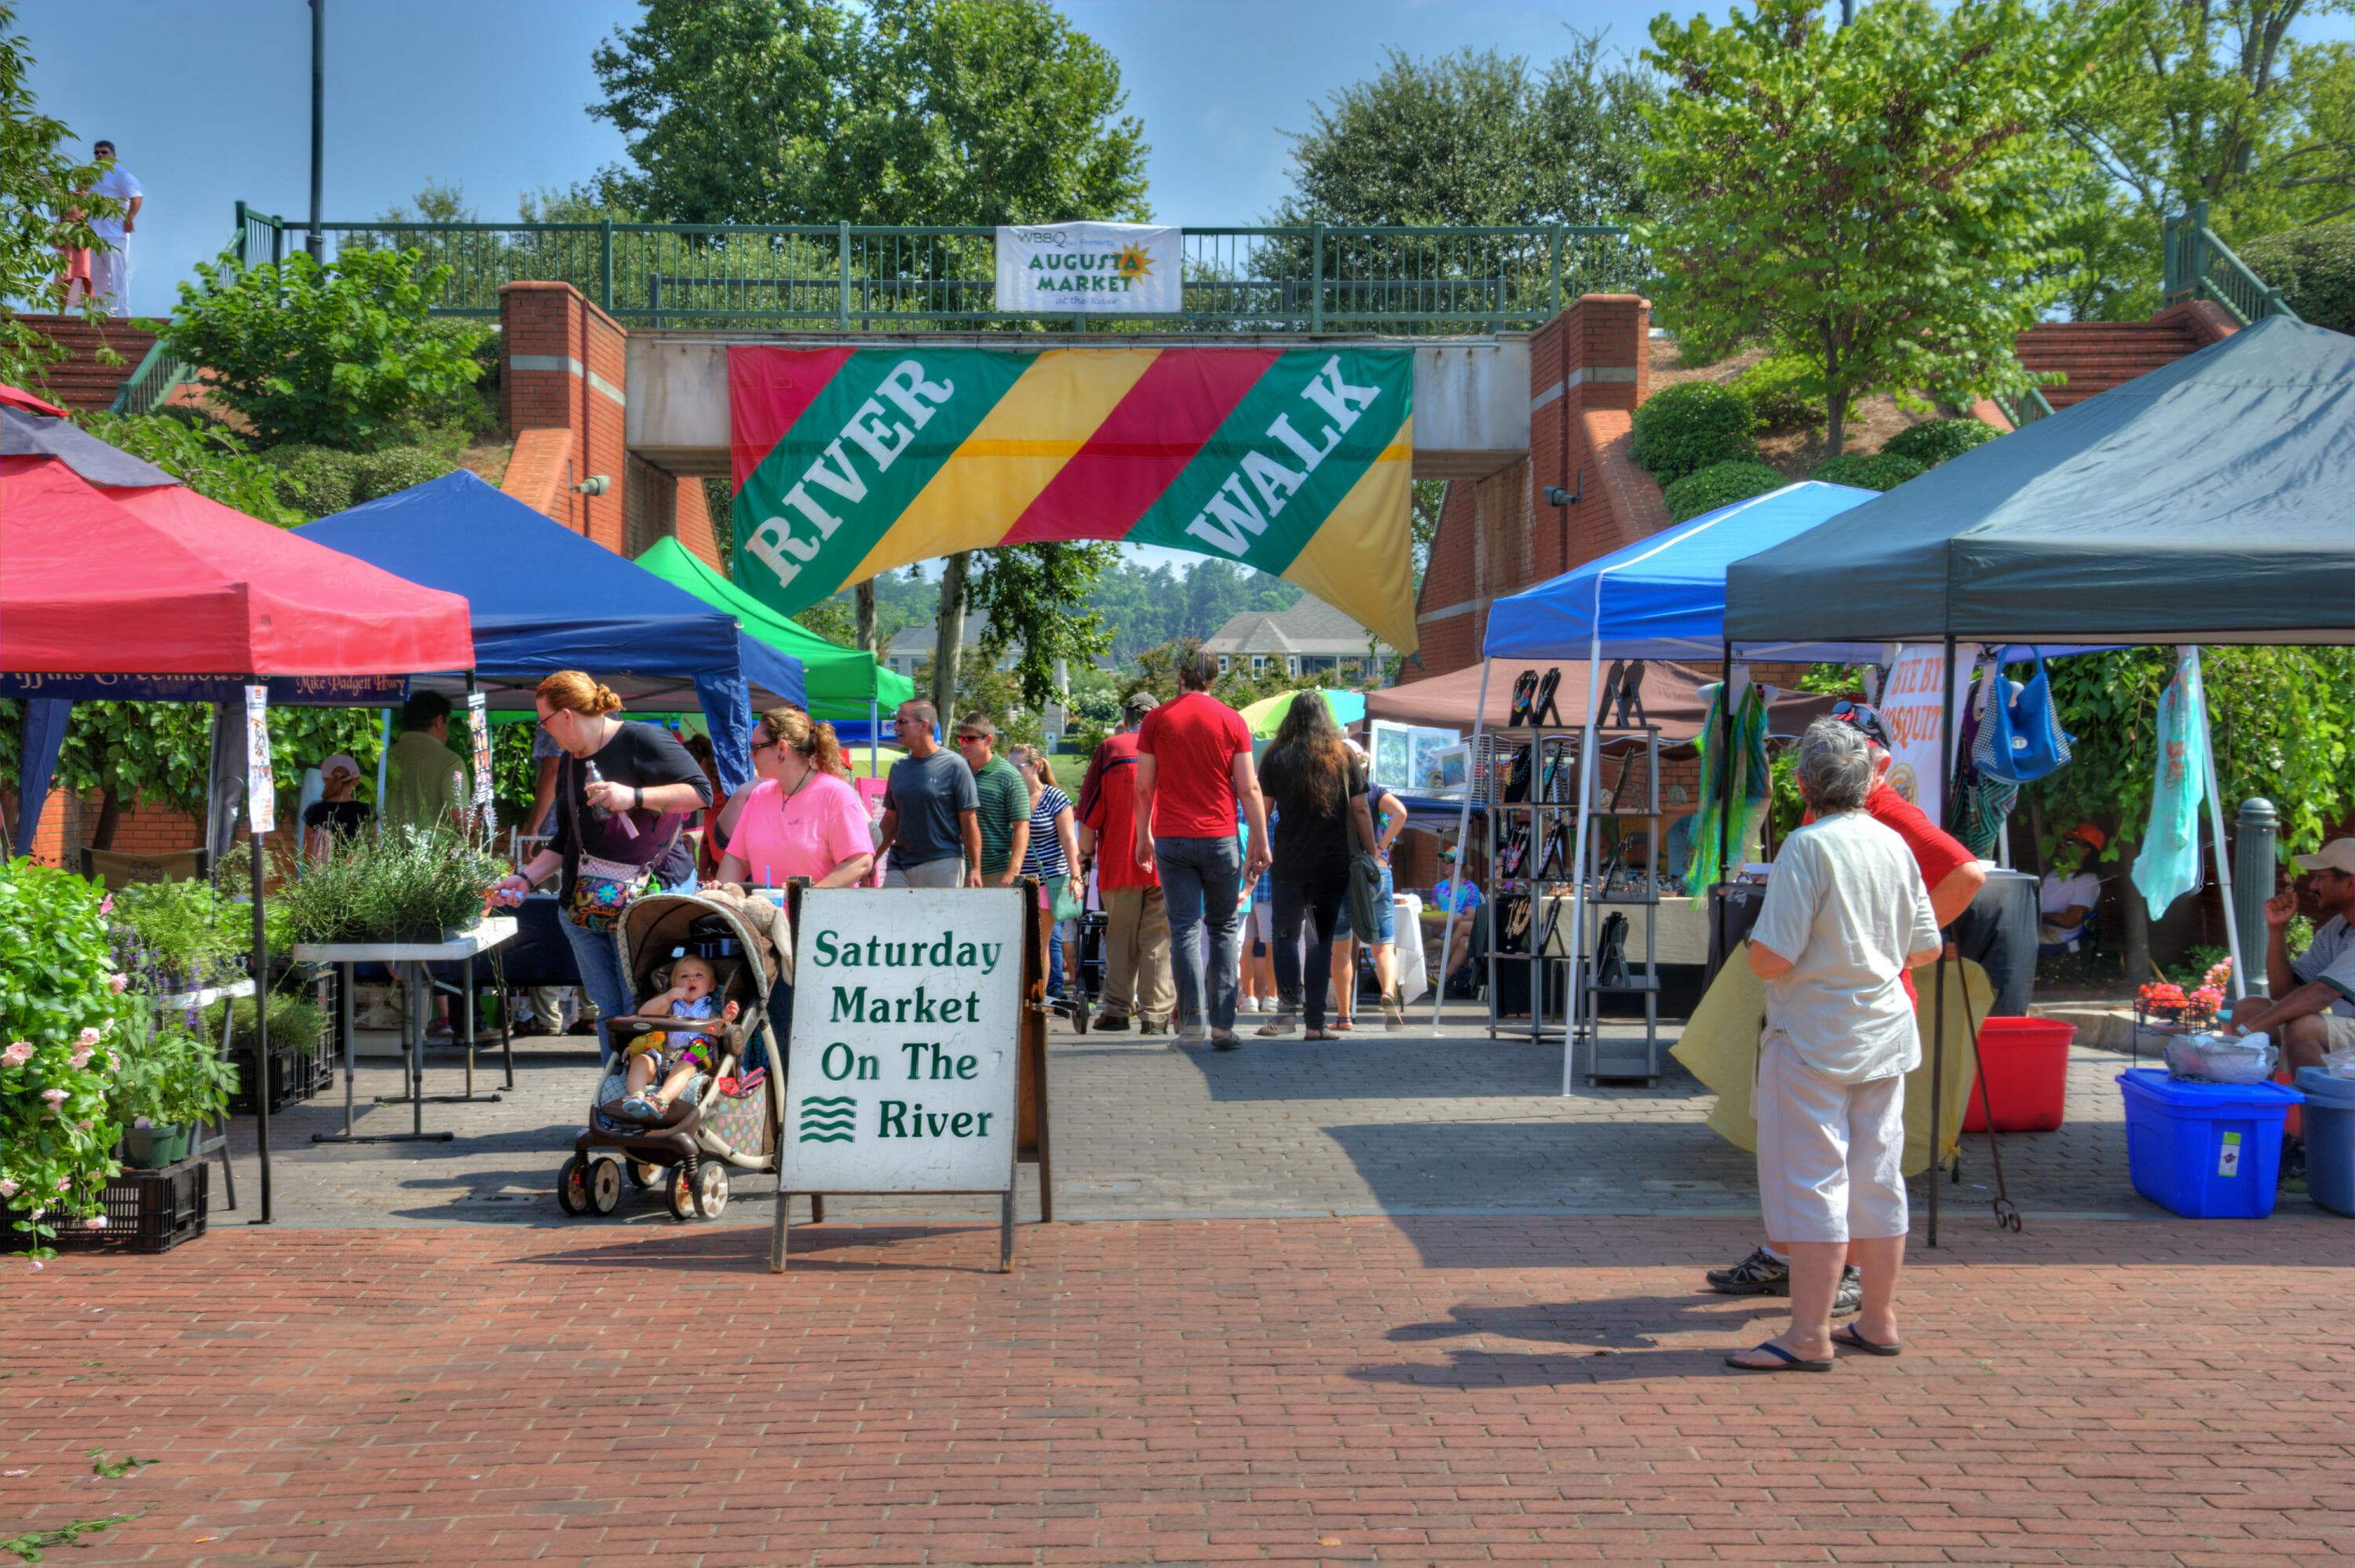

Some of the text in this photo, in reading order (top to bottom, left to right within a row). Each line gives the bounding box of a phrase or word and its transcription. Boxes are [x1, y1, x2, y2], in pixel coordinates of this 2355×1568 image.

[1018, 232, 1066, 248] WBBQ
[1029, 253, 1139, 271] AUGUSTA
[1037, 275, 1131, 291] MARKET
[745, 354, 1382, 588] RIVER WALK
[296, 675, 326, 694] Mike
[328, 675, 371, 696] Padgett
[1890, 658, 1922, 695] BYE
[813, 929, 1002, 975] Saturday
[830, 986, 980, 1023] Market
[822, 1042, 979, 1081] On The
[878, 1100, 994, 1138] River
